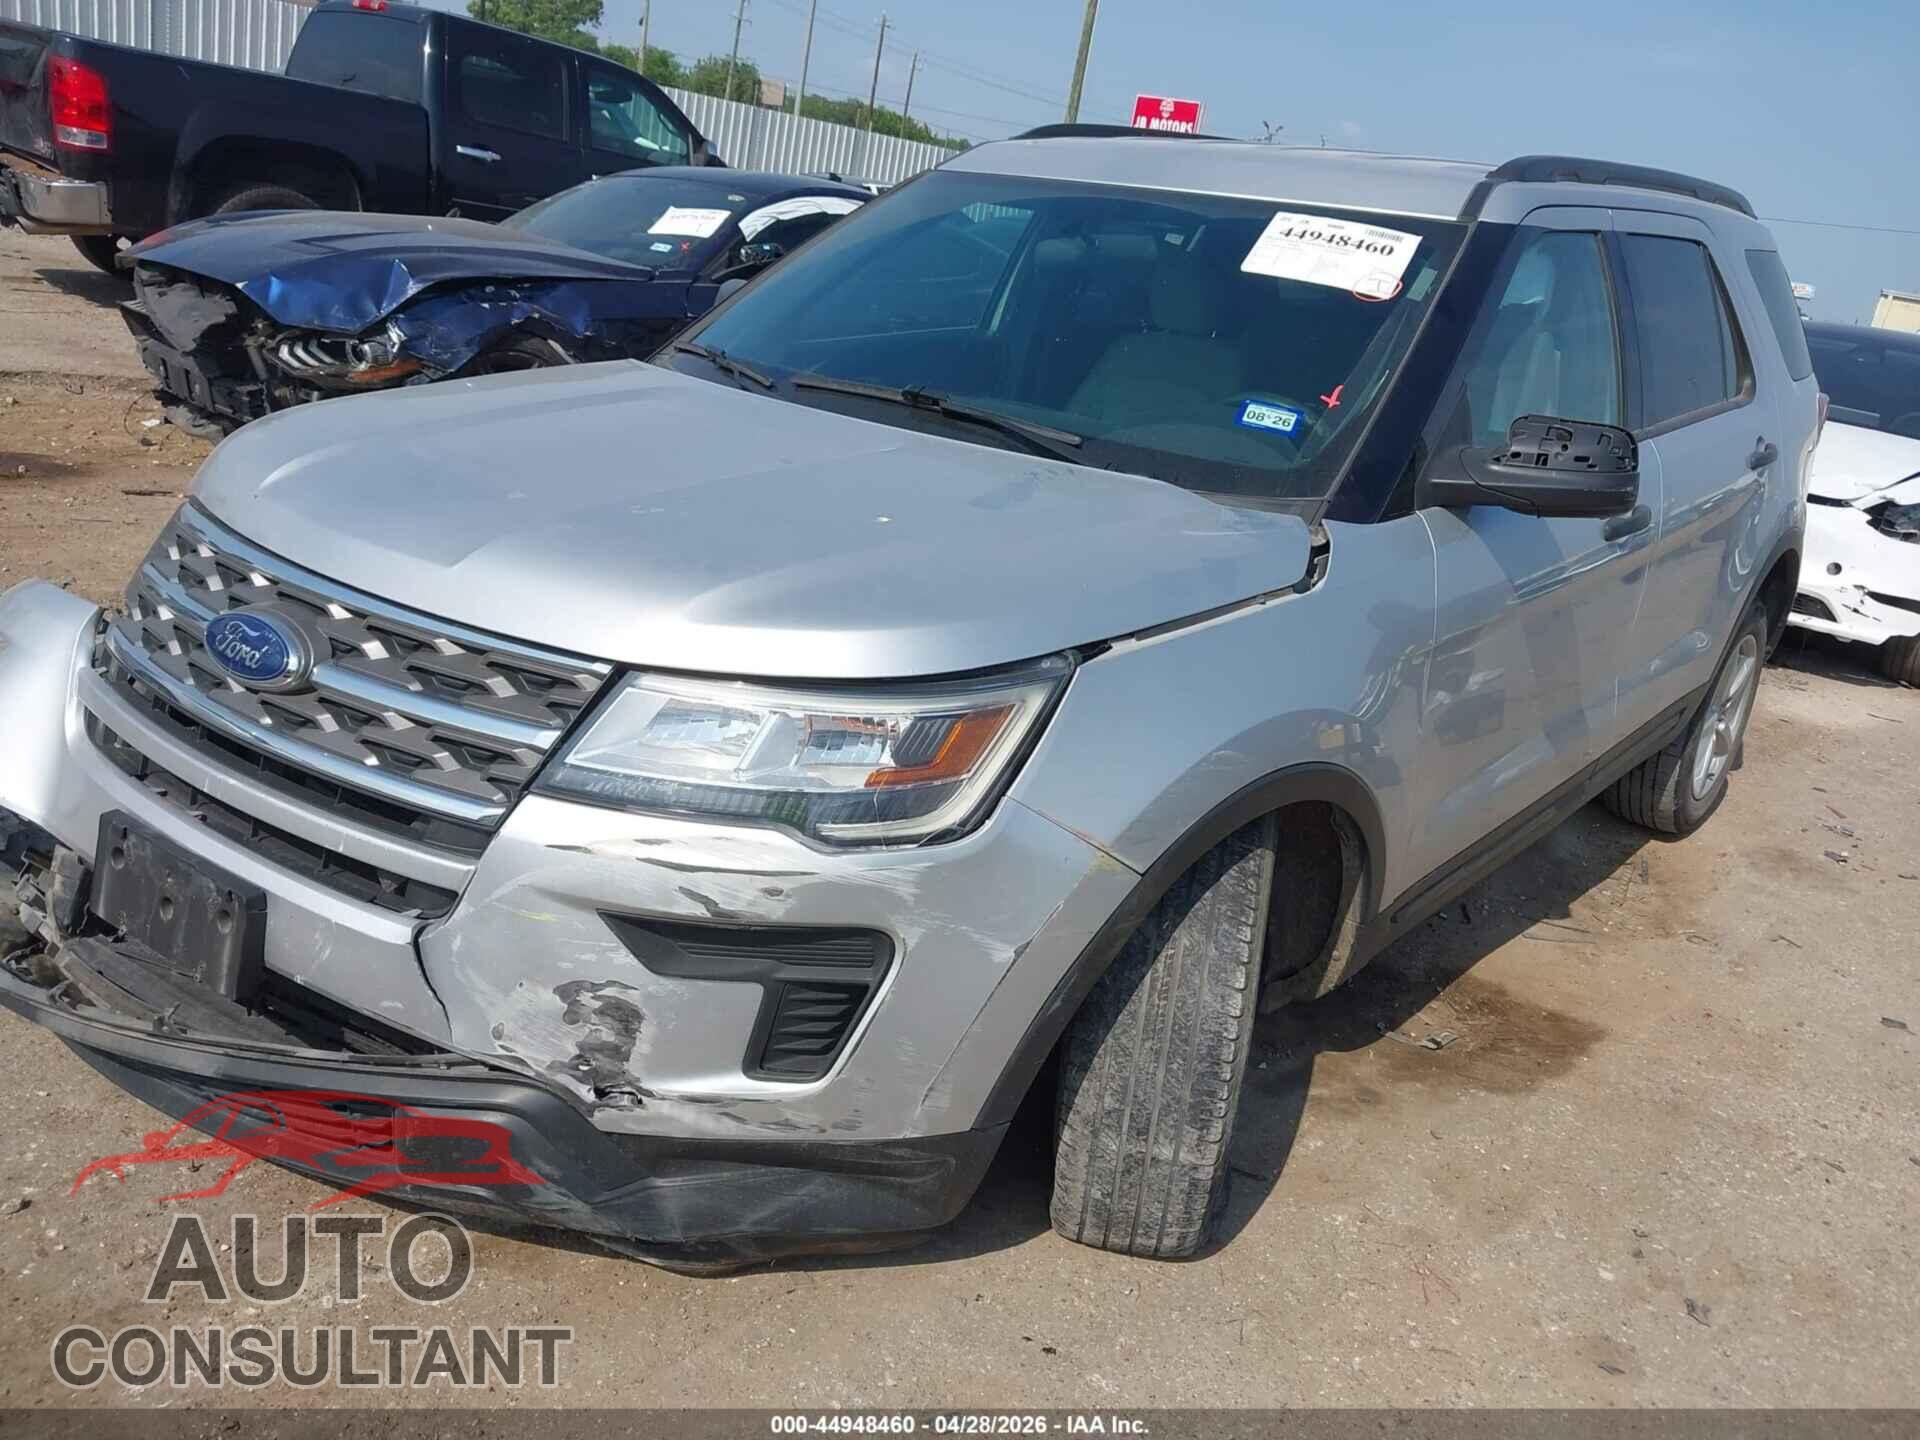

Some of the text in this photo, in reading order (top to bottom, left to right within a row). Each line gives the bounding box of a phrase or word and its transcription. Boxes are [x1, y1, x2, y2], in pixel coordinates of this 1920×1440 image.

[1149, 117, 1194, 134] MOTORS
[1279, 226, 1395, 257] 44948460
[1246, 410, 1266, 422] 08
[1272, 415, 1293, 428] 26
[215, 620, 269, 670] Ford
